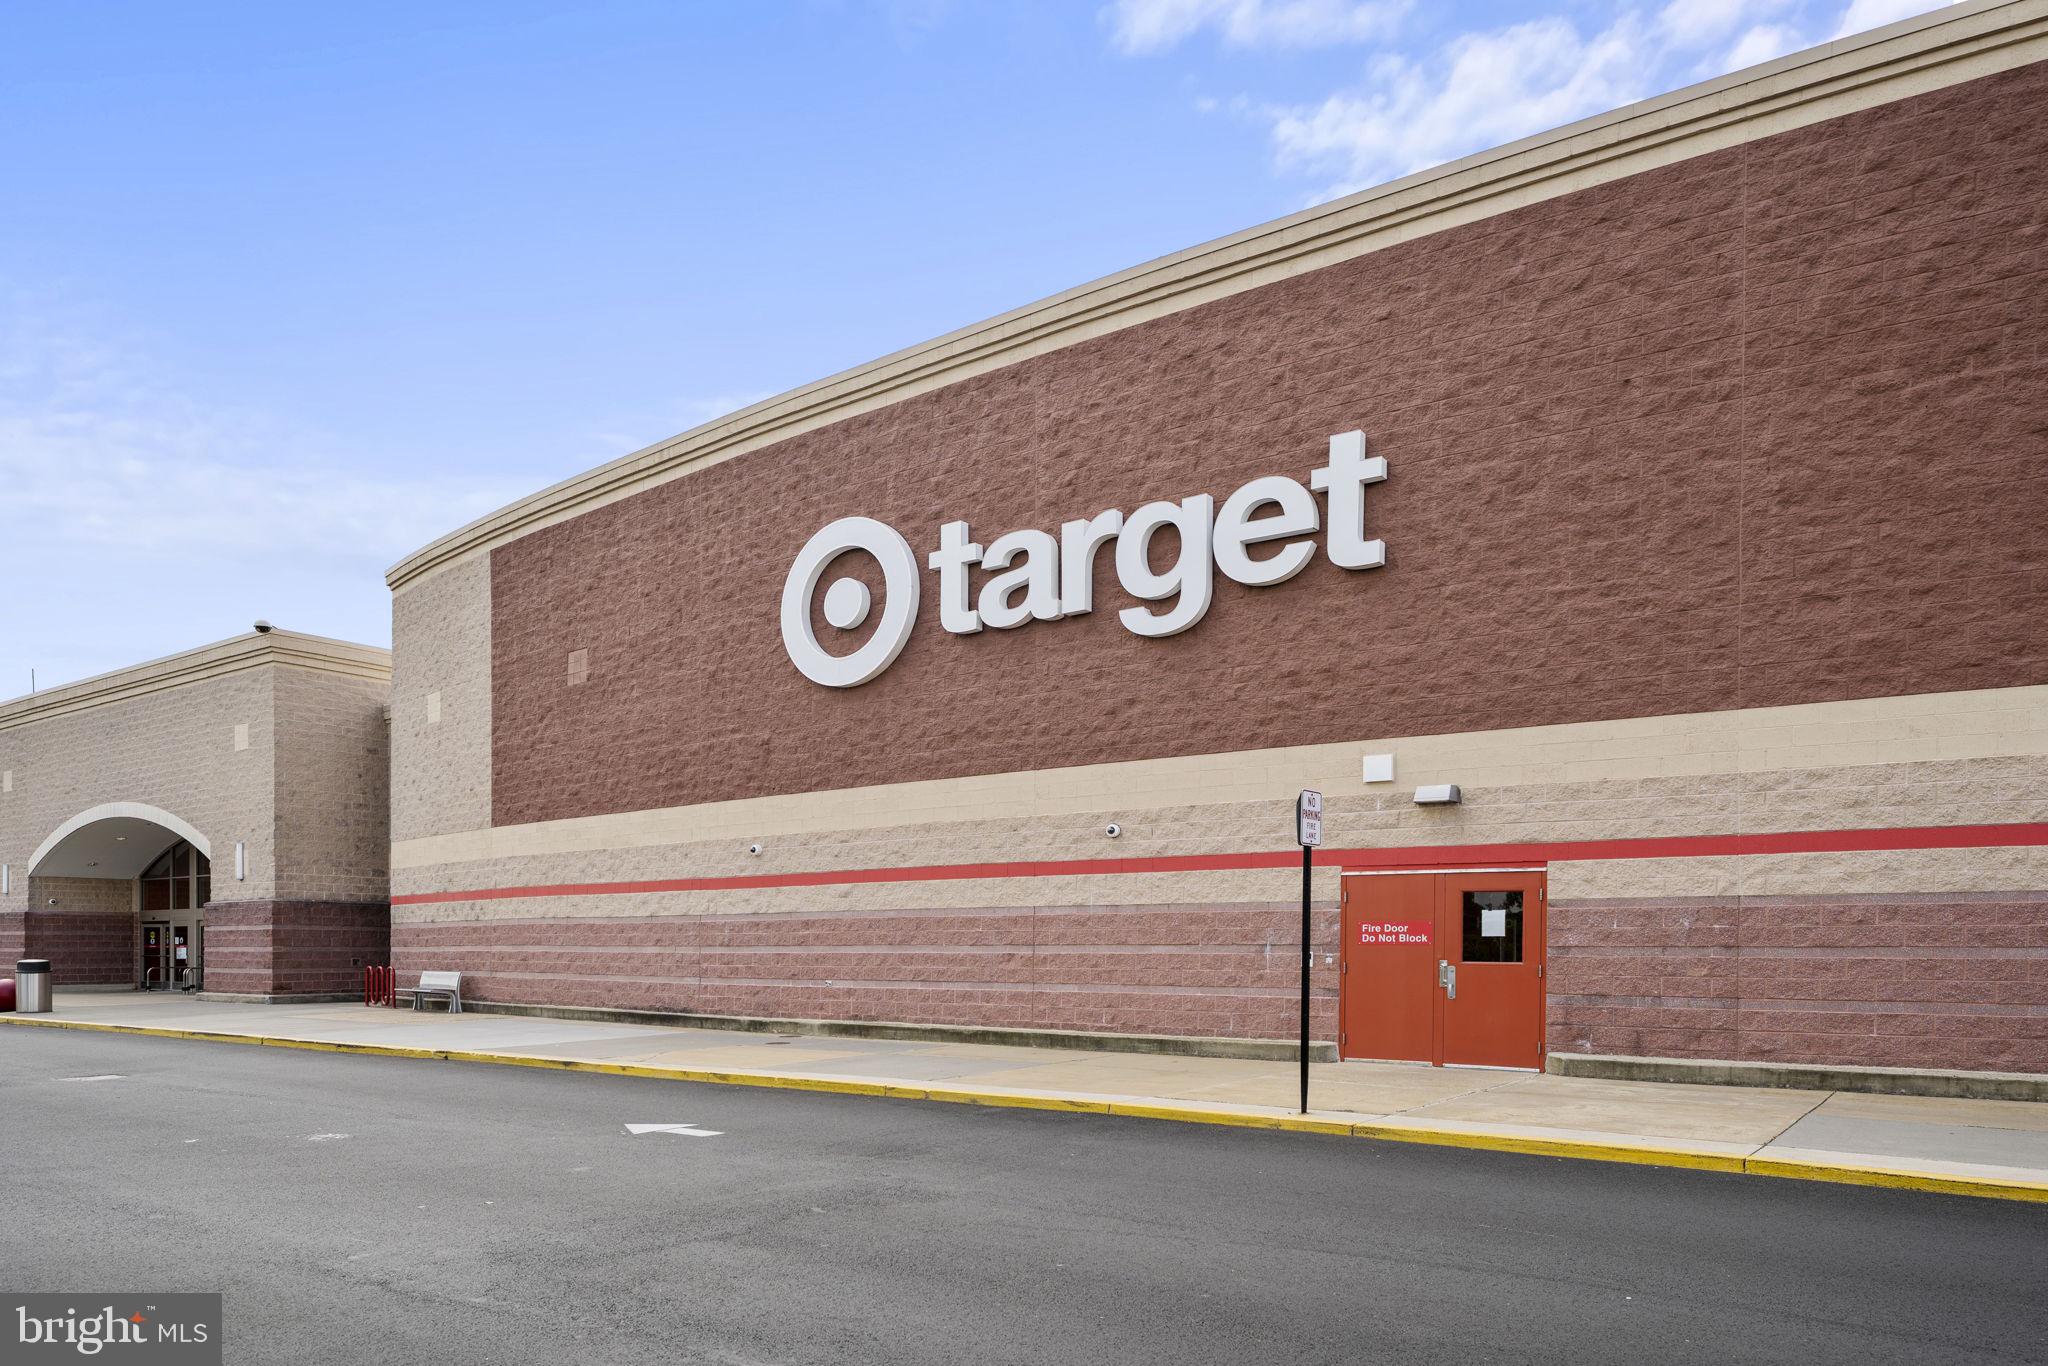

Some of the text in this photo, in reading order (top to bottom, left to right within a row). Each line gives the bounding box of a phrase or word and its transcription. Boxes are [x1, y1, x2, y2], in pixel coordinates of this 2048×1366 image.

[928, 429, 1387, 637] target
[1307, 796, 1316, 807] NO
[1302, 809, 1321, 821] PARKING
[1362, 924, 1408, 932] Fire Door
[1362, 934, 1428, 943] Do Not Block
